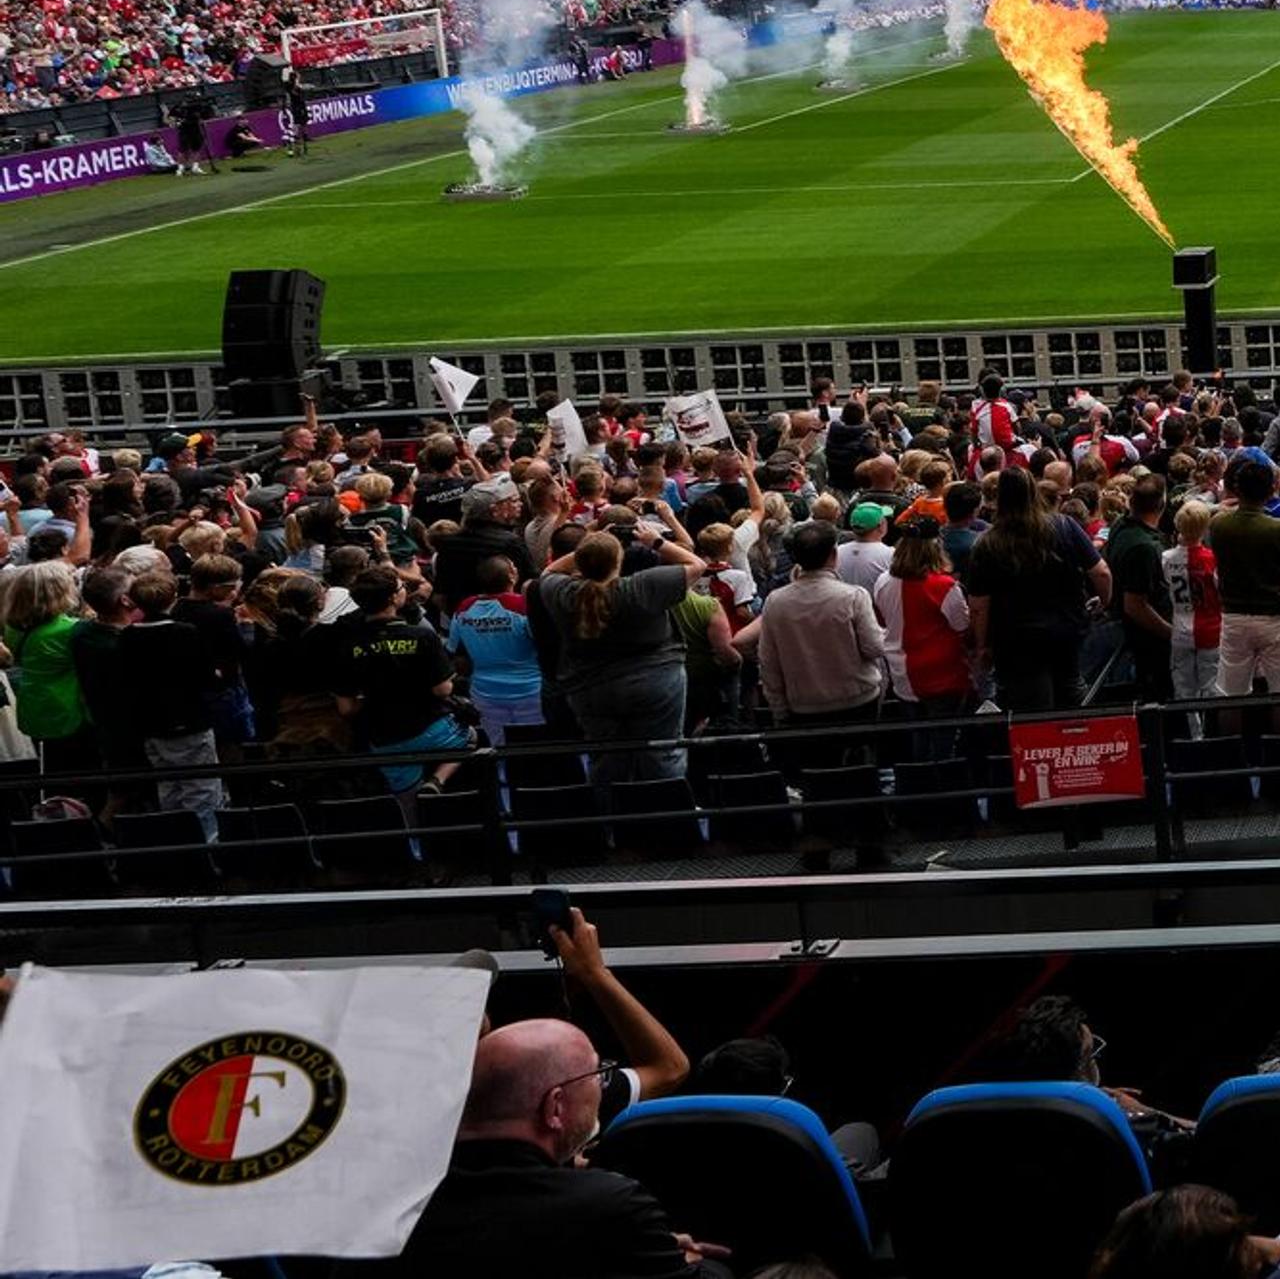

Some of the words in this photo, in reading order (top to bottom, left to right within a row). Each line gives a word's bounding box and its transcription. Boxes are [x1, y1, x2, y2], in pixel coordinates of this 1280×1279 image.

[1024, 747, 1061, 761] LEVER
[162, 1035, 338, 1089] FEYENOORD
[200, 1069, 287, 1146] F
[145, 1123, 325, 1183] ROTTERDAM
